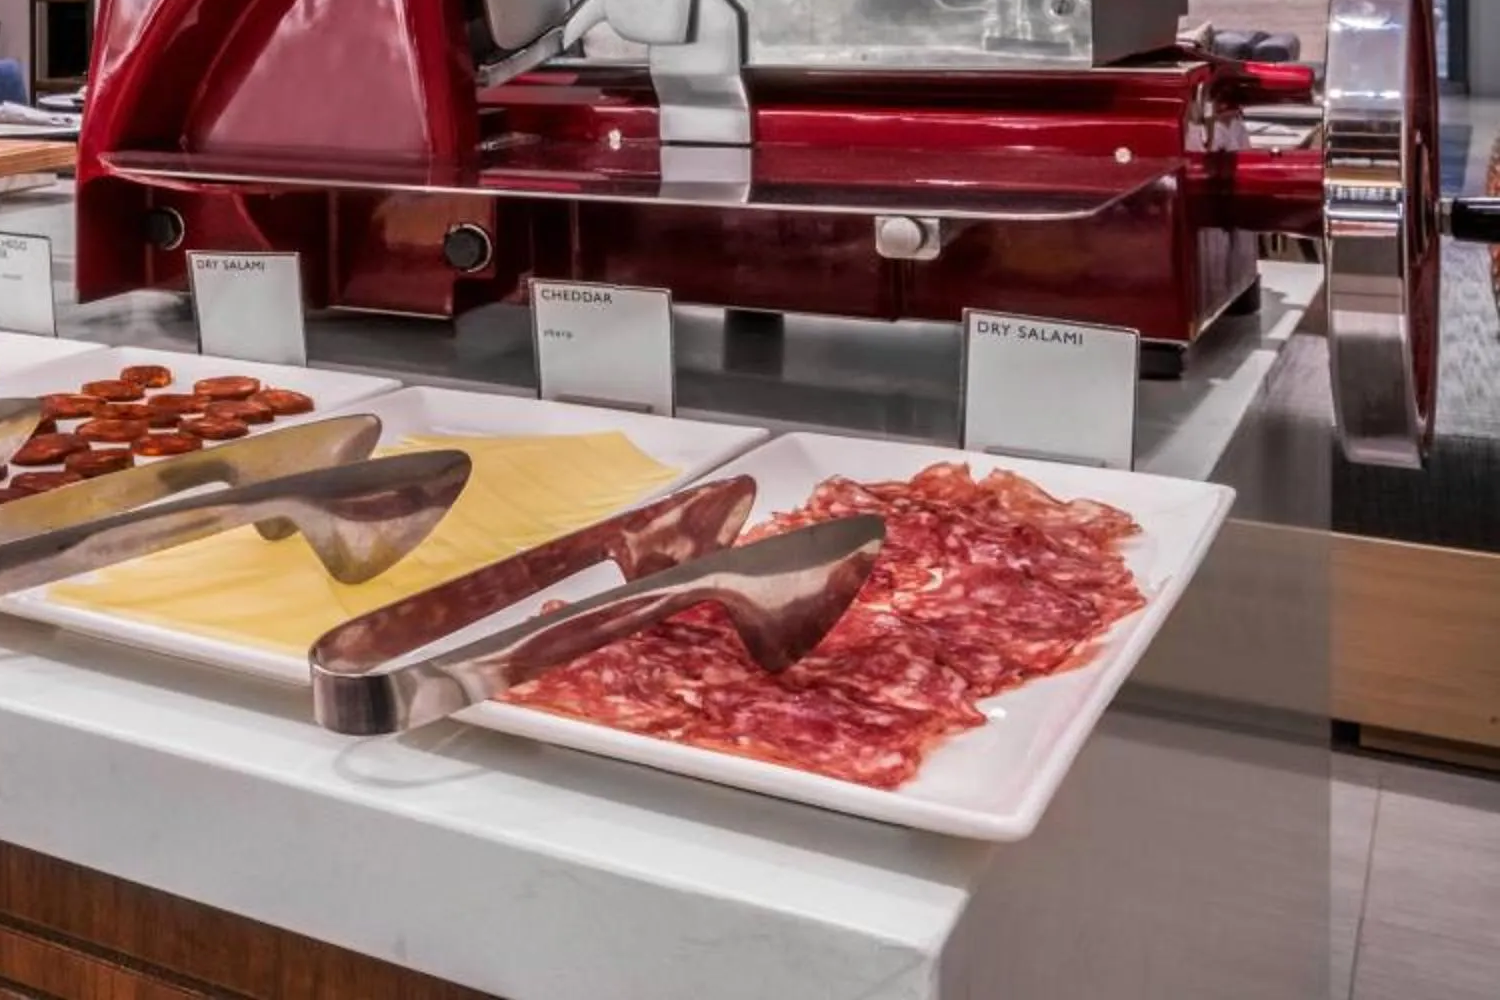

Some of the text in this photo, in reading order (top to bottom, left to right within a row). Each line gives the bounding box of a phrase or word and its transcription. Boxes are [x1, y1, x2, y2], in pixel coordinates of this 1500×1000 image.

[196, 259, 266, 272] DRY SALAMI
[541, 289, 613, 305] CHEDDAR
[977, 321, 1084, 346] DRY SALAMI
